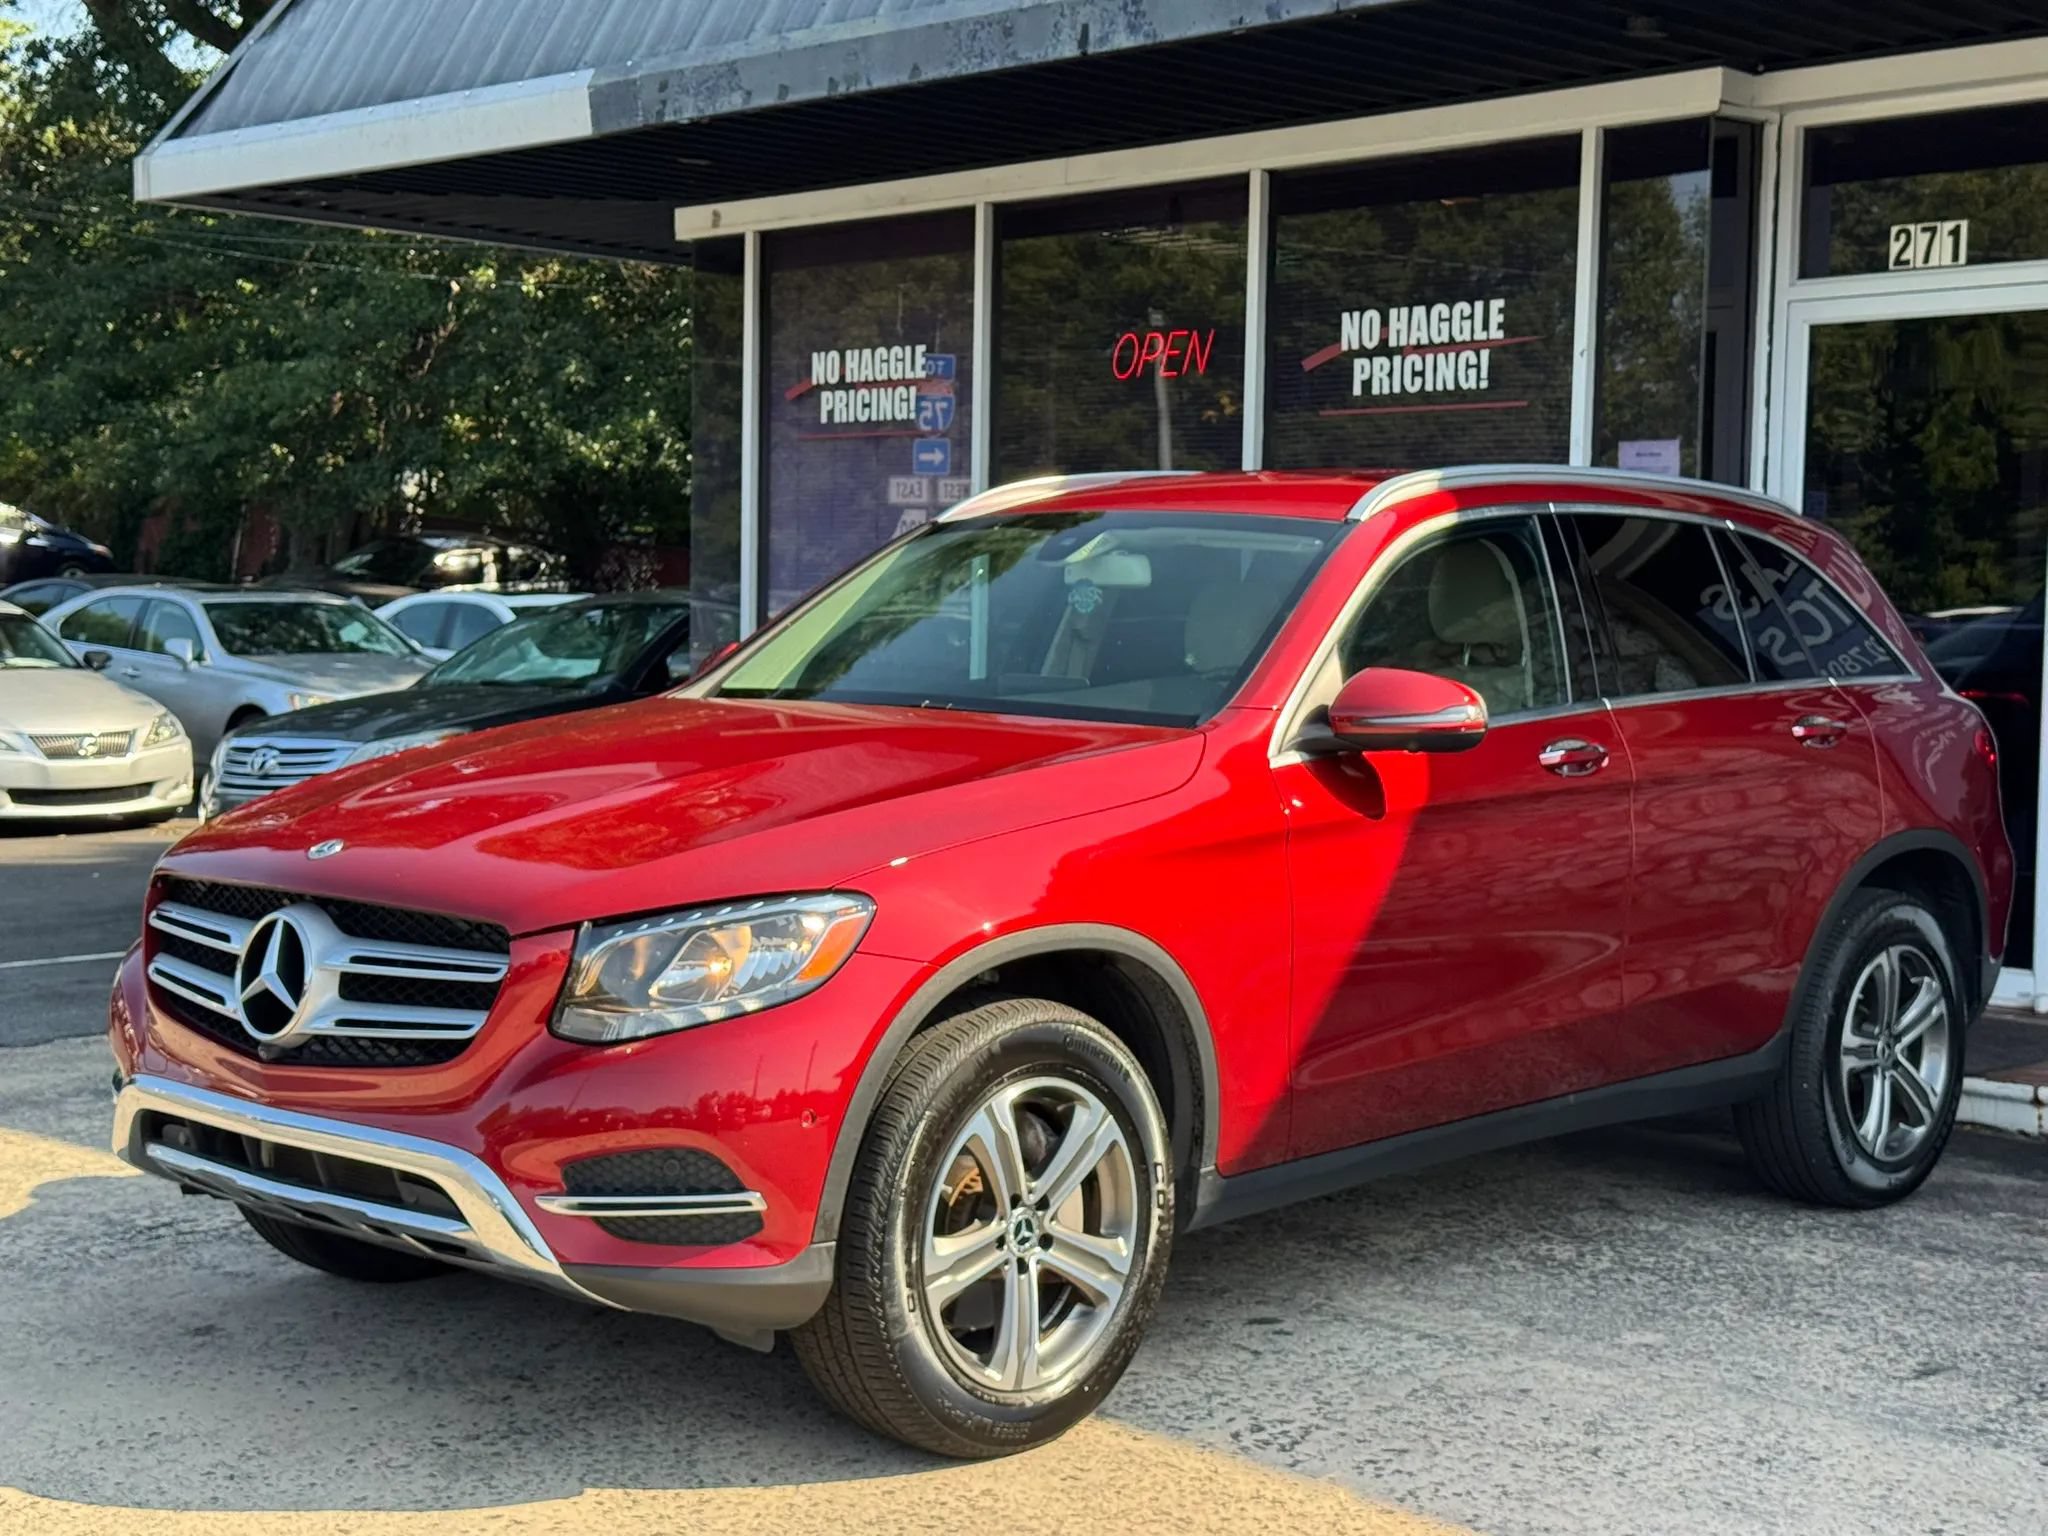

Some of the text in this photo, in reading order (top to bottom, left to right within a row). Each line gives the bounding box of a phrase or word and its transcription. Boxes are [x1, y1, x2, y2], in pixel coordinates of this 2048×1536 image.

[1893, 223, 1961, 266] 271
[1341, 298, 1505, 351] NO HAGGLE
[811, 344, 927, 385] NO HAGGLE
[1112, 328, 1214, 379] OPEN
[1352, 348, 1490, 396] PRICING!
[820, 385, 917, 424] PRICING!
